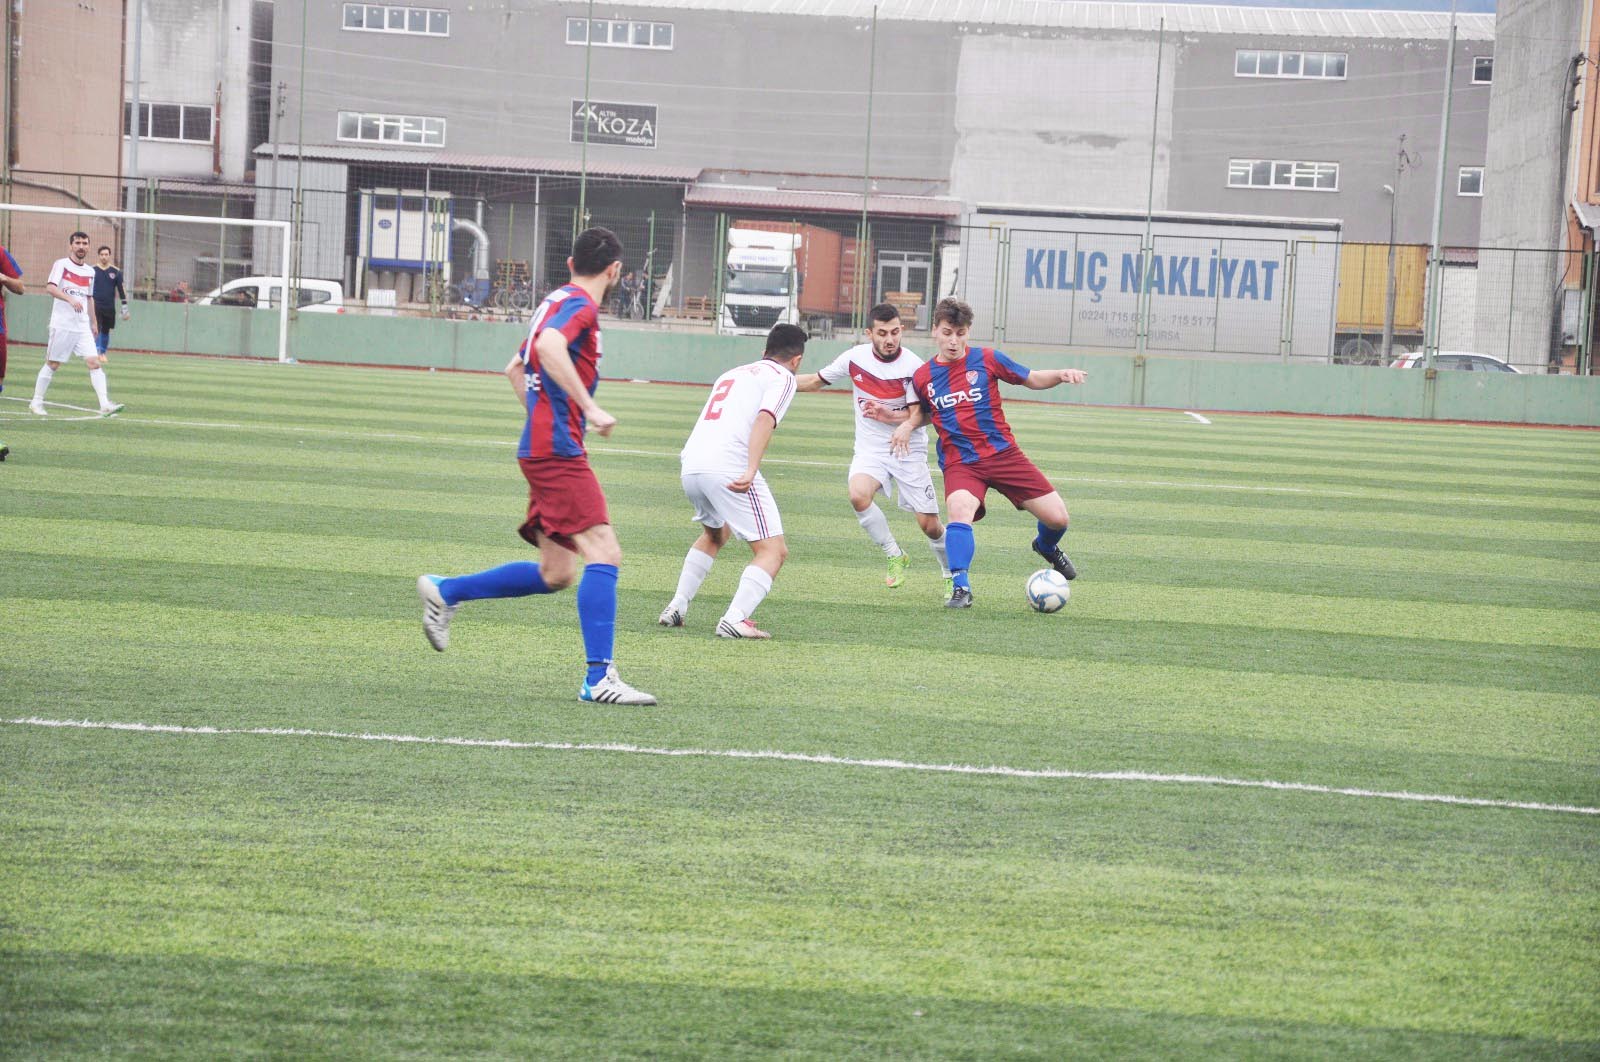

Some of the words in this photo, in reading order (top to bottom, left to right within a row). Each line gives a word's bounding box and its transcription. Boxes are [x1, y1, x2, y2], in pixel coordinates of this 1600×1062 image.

[598, 117, 653, 136] KOZA
[1024, 248, 1108, 303] KILIÇ
[1120, 248, 1279, 301] NAKLİYAT
[704, 379, 735, 420] 2
[927, 382, 936, 398] 8
